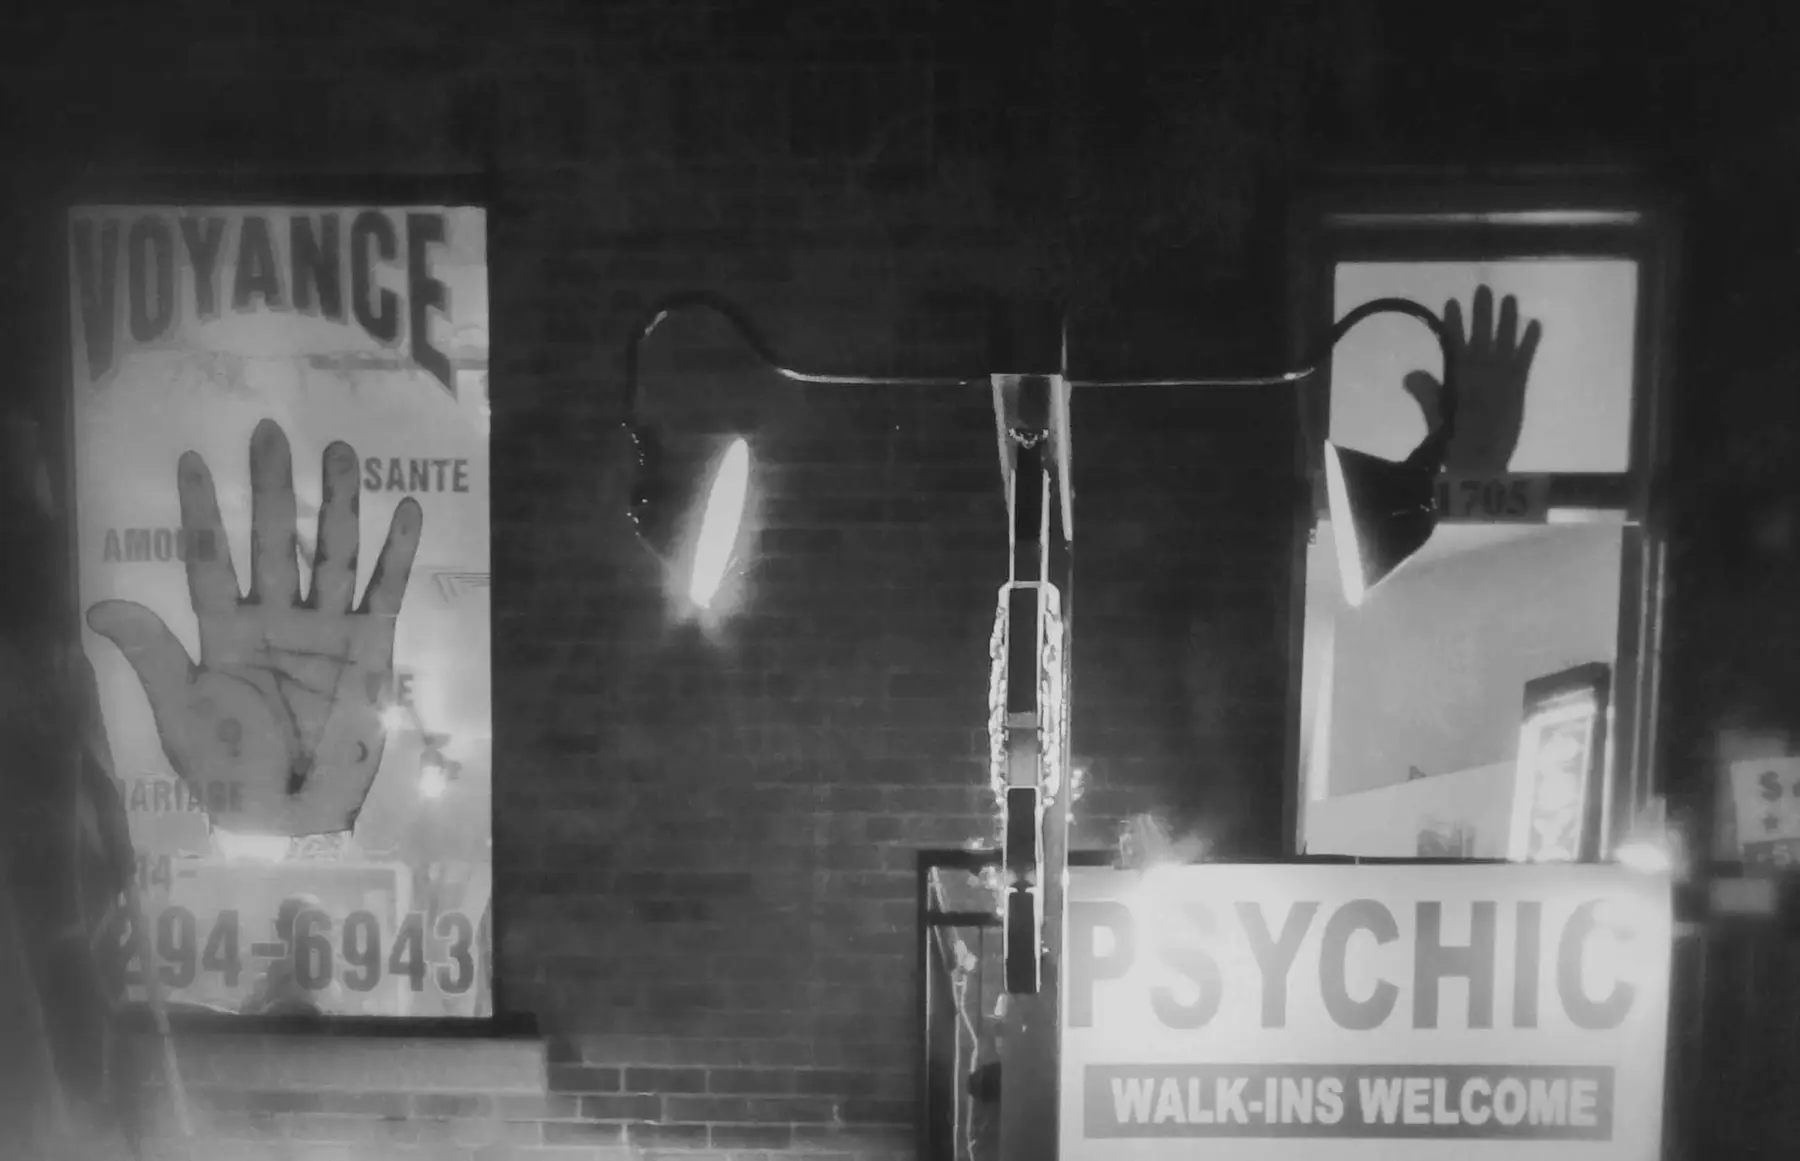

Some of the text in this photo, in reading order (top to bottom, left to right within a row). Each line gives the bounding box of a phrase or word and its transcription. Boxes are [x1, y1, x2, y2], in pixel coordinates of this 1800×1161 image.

[73, 210, 457, 403] VOYANCE
[363, 456, 470, 493] SANTE
[1067, 899, 1638, 1031] PSYCHIC
[1111, 1076, 1599, 1126] WALK-INS WELCOME
